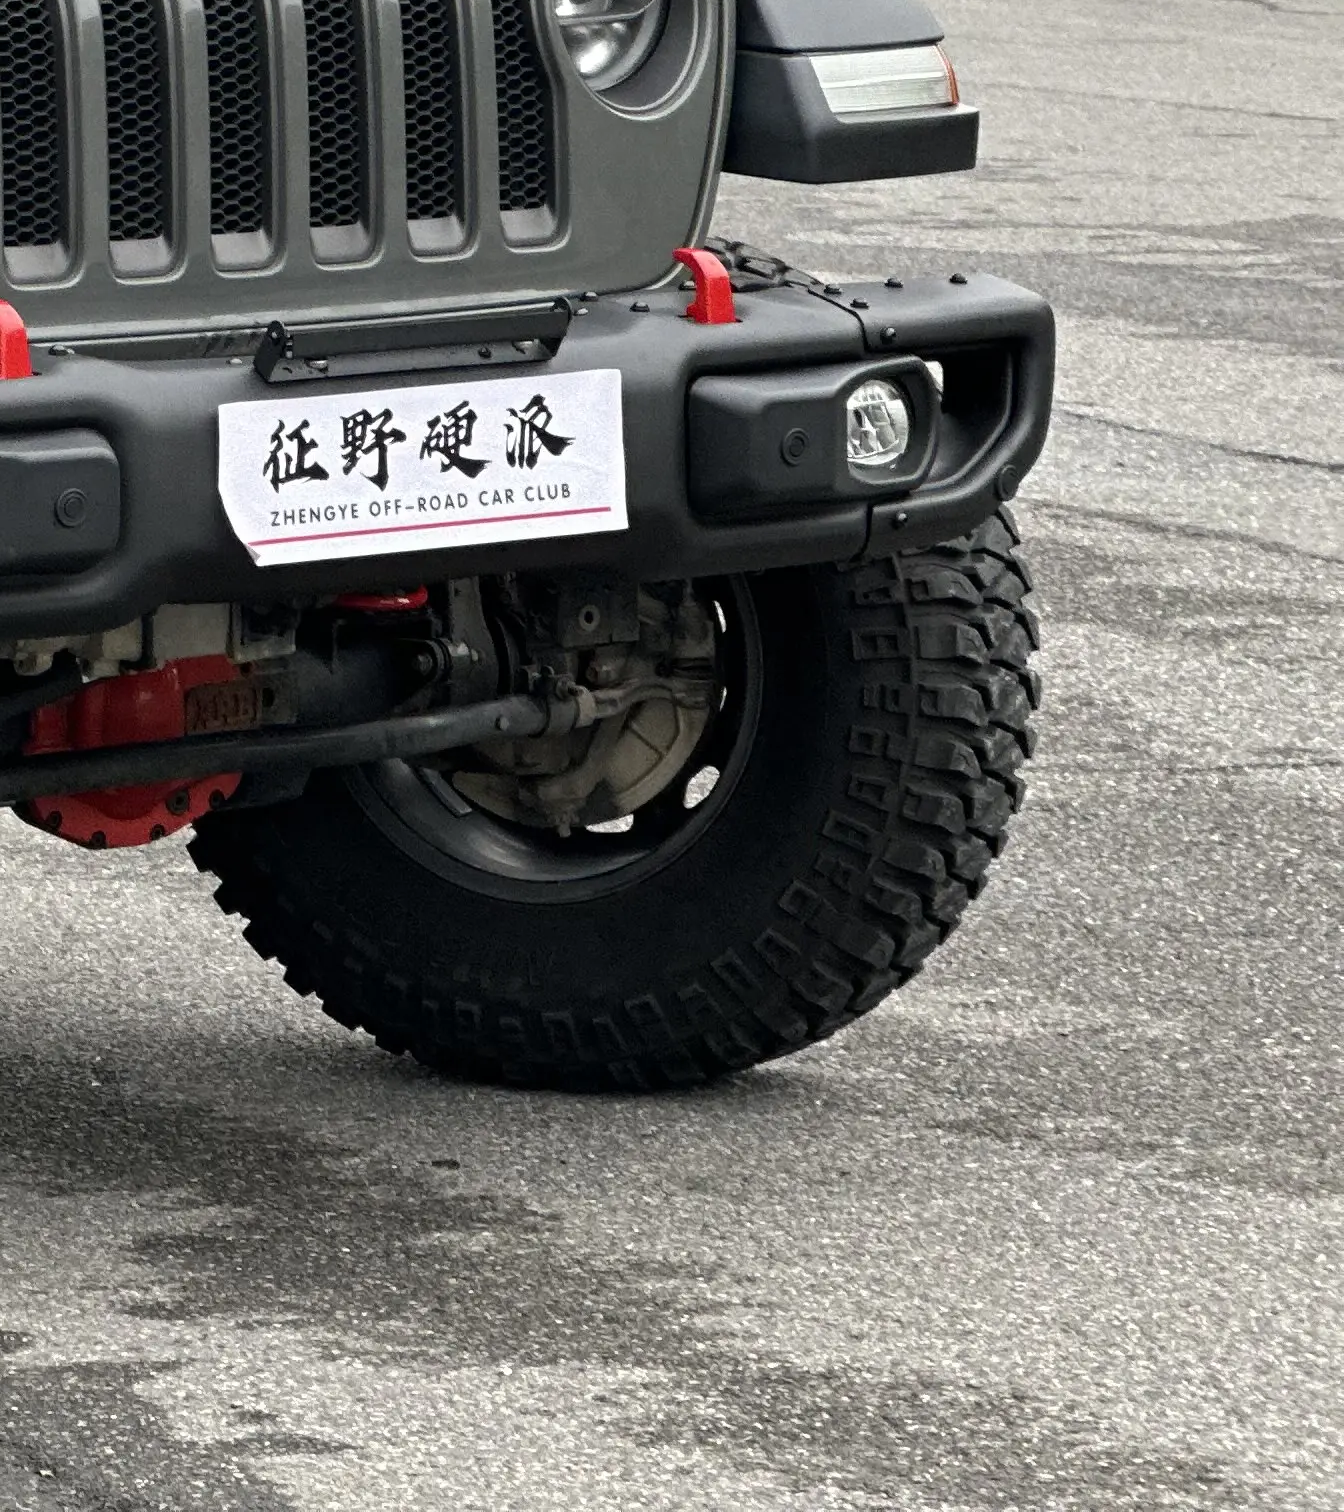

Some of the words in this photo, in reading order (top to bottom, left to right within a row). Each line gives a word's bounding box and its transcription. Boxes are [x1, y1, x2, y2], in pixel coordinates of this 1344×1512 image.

[262, 393, 576, 495] 征野硬派
[270, 503, 359, 528] ZHENGYE
[368, 492, 469, 518] OFF-ROAD
[478, 488, 514, 506] CAR
[524, 483, 572, 503] CLUB
